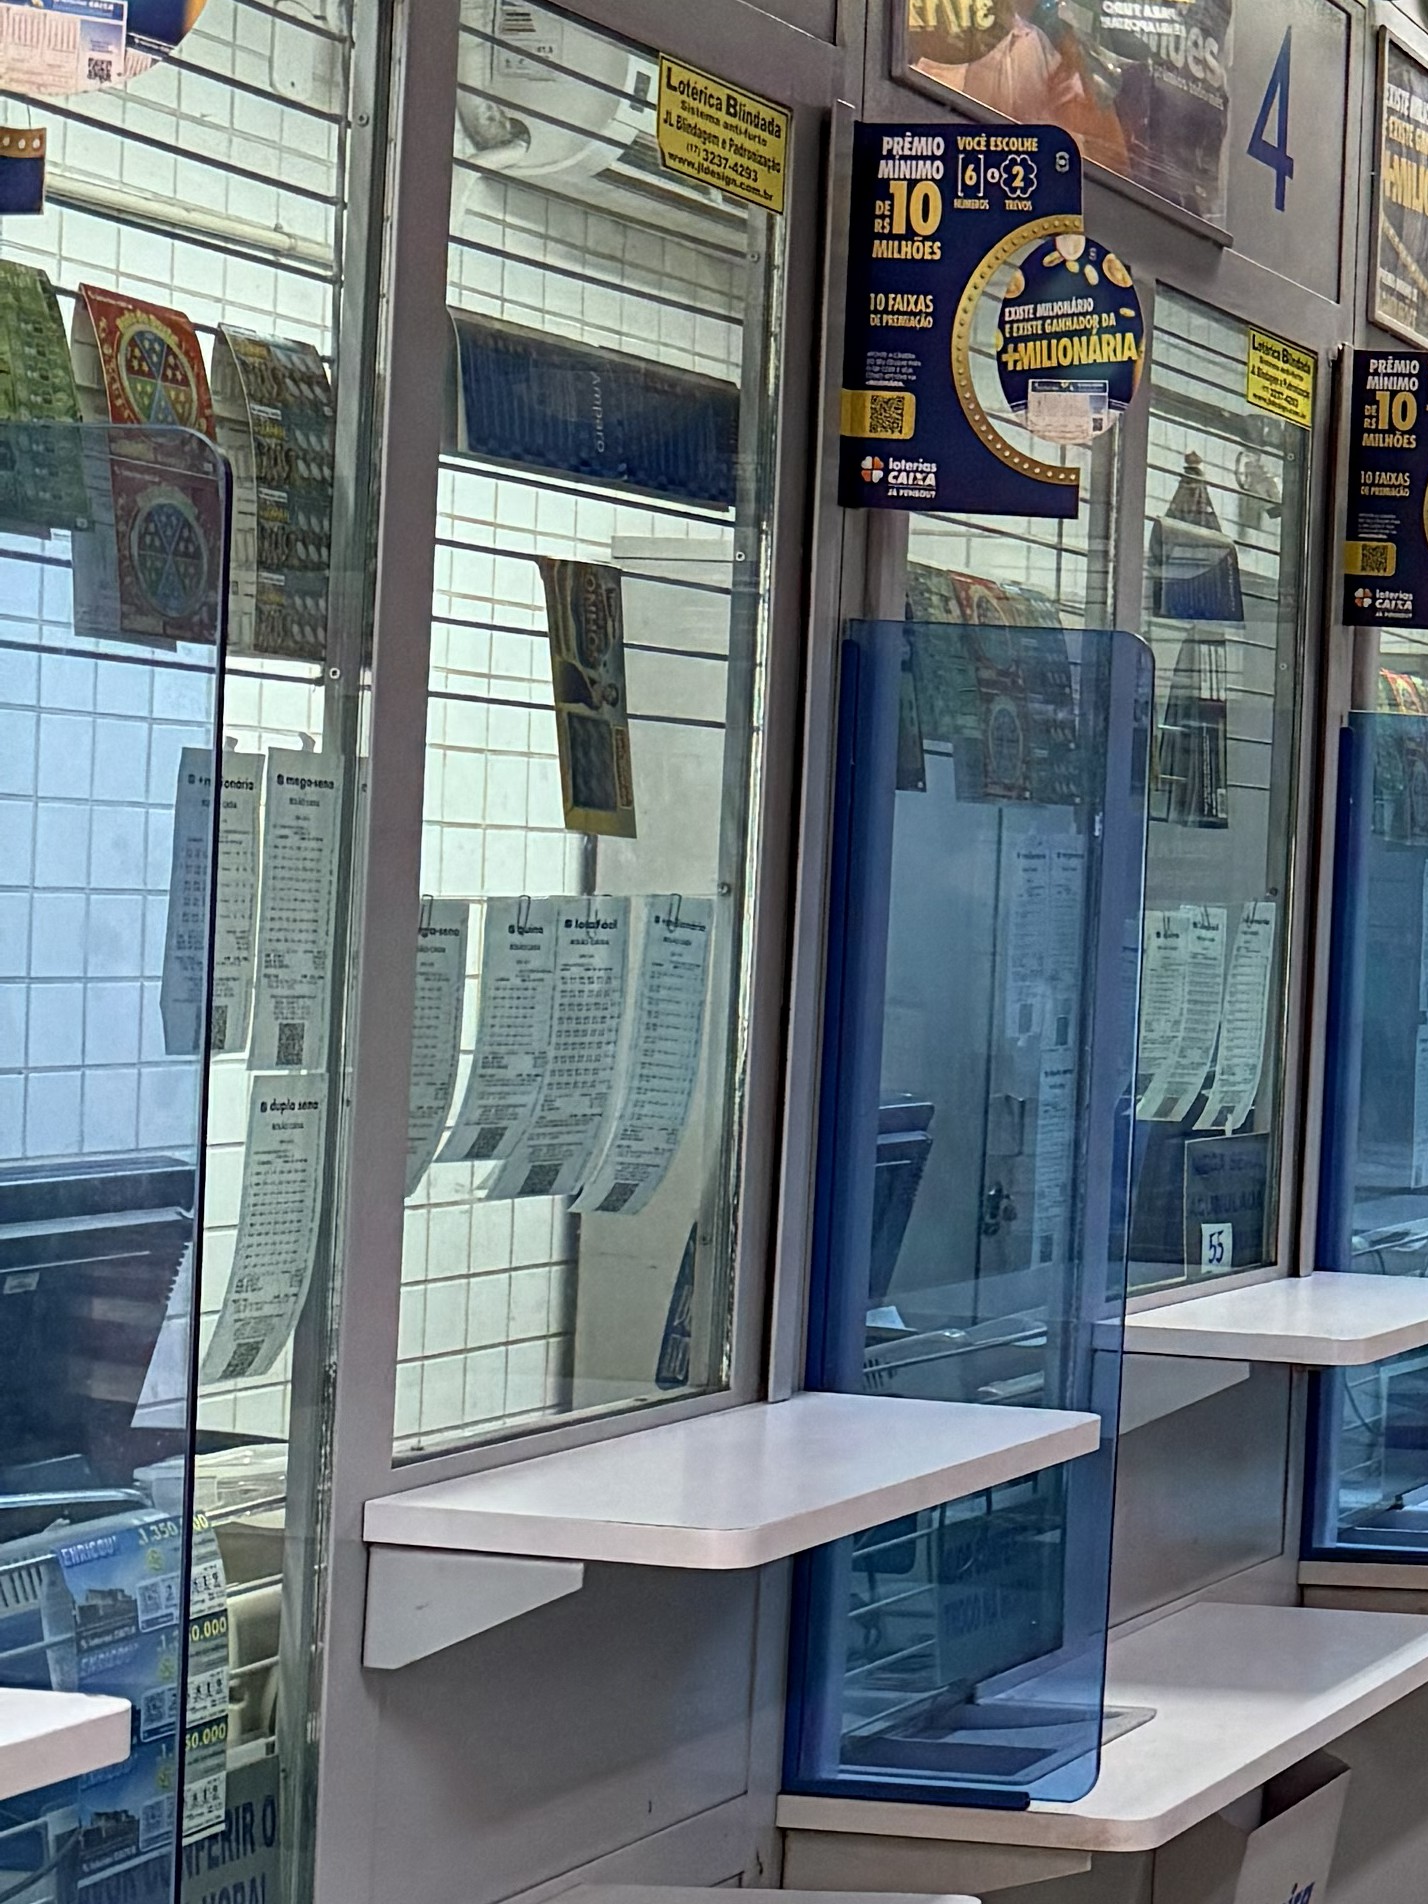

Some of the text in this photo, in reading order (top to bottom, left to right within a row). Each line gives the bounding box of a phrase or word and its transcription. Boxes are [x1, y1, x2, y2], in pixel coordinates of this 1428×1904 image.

[666, 66, 781, 139] Lotérica Blindada
[676, 115, 719, 144] Blindagem
[1247, 26, 1294, 212] 4
[883, 132, 944, 156] PRÊMIO
[957, 134, 1038, 151] VOCÊ ESCOLHE
[878, 155, 944, 179] MÍNIMO
[964, 167, 1024, 187] 6 2
[874, 180, 942, 236] R$ 10
[875, 200, 891, 215] DE
[872, 237, 941, 260] MILHÕES
[870, 293, 934, 313] 10 FAIXAS
[1045, 316, 1099, 333] GANHADOR
[1101, 313, 1116, 326] DA
[1367, 375, 1419, 390] MÍNIMO
[1376, 392, 1417, 431] 10
